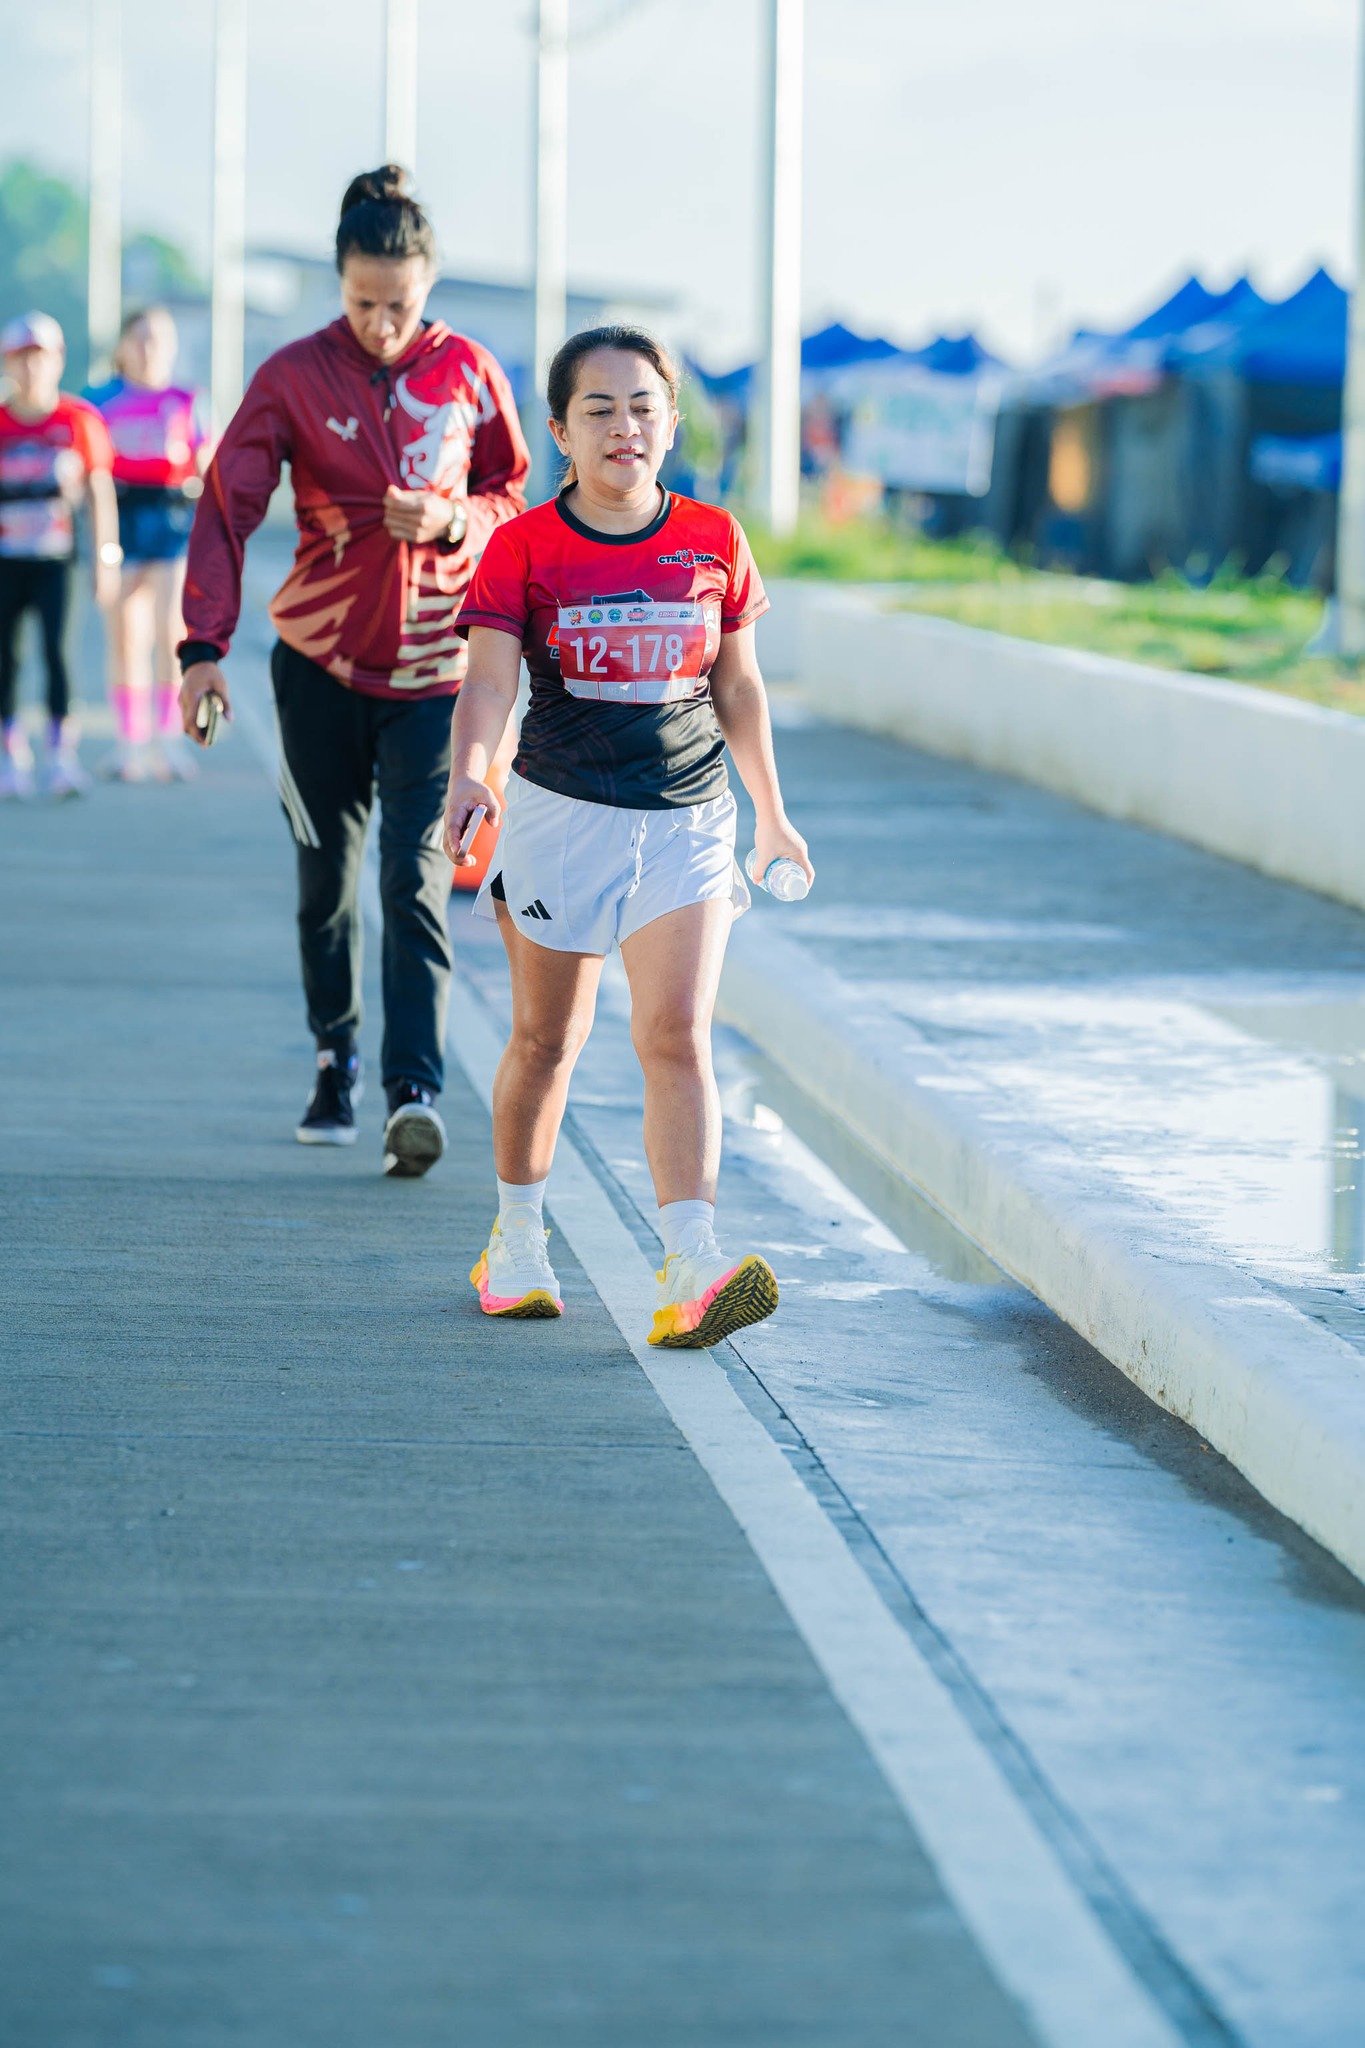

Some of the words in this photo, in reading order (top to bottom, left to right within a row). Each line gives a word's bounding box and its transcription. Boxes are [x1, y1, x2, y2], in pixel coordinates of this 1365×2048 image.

[658, 555, 682, 564] CTRL
[694, 553, 715, 563] RUN
[570, 634, 683, 674] 12-178
